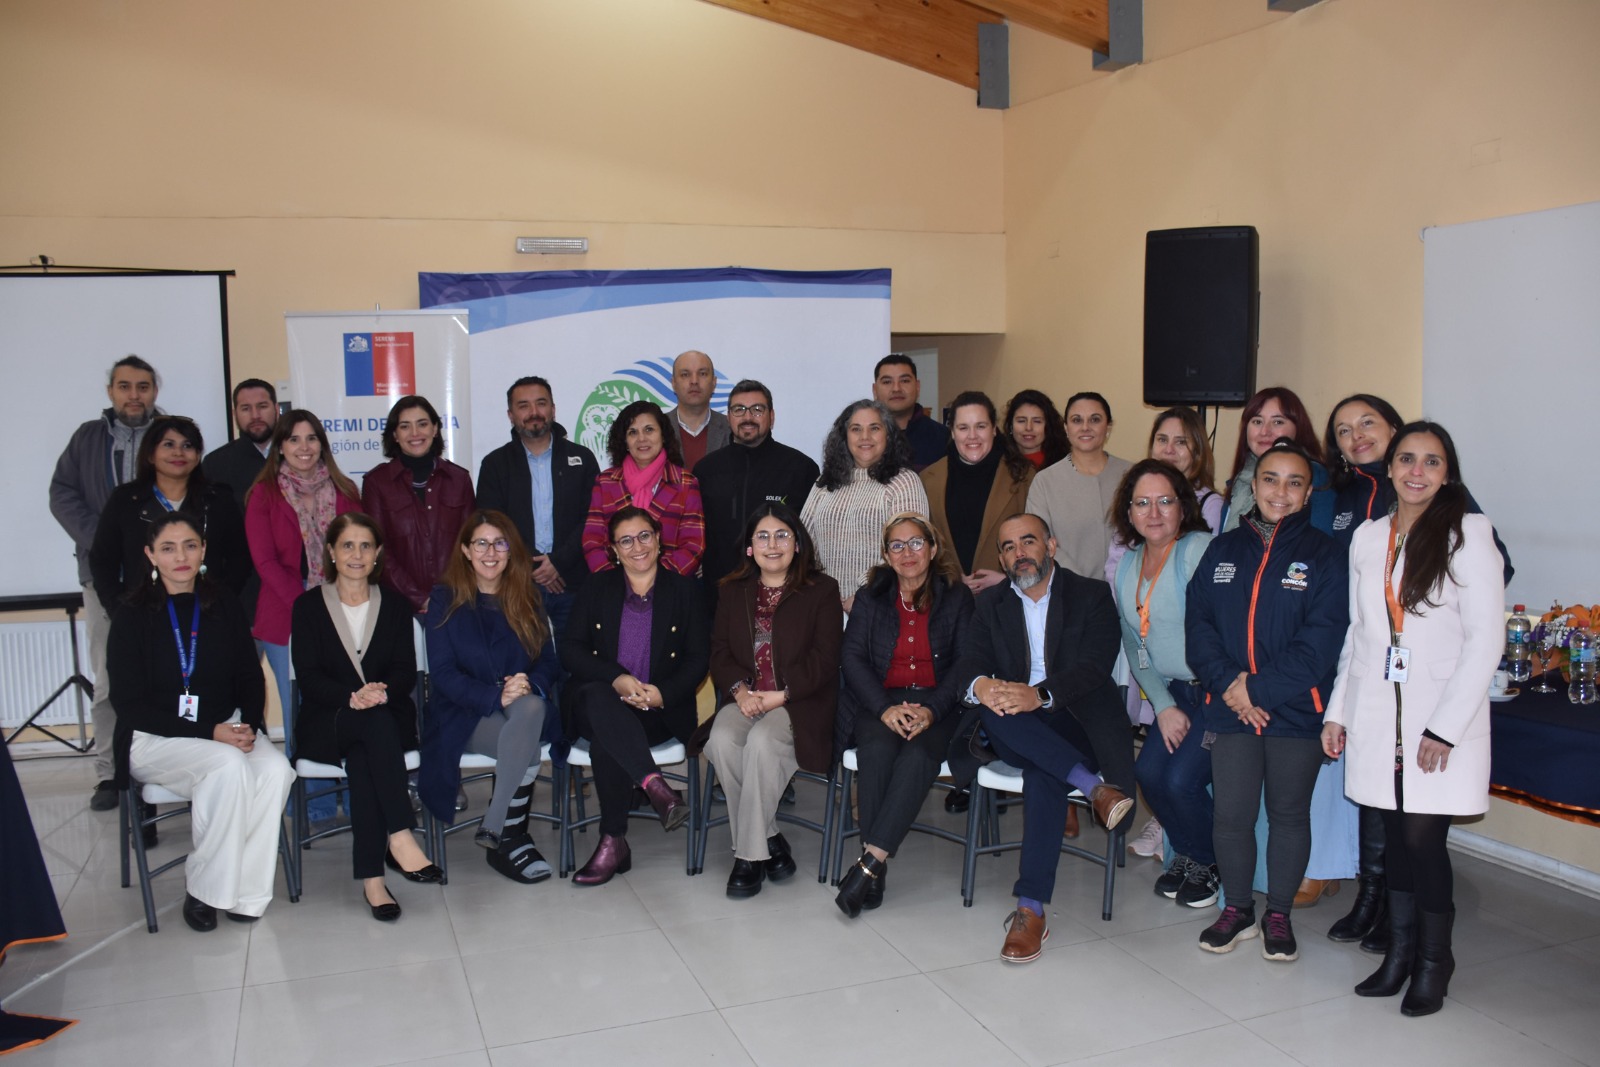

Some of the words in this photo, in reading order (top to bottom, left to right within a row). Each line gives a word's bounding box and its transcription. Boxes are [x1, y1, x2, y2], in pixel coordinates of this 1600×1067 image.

[320, 418, 363, 432] REMI
[331, 439, 360, 455] gión
[363, 438, 380, 451] de
